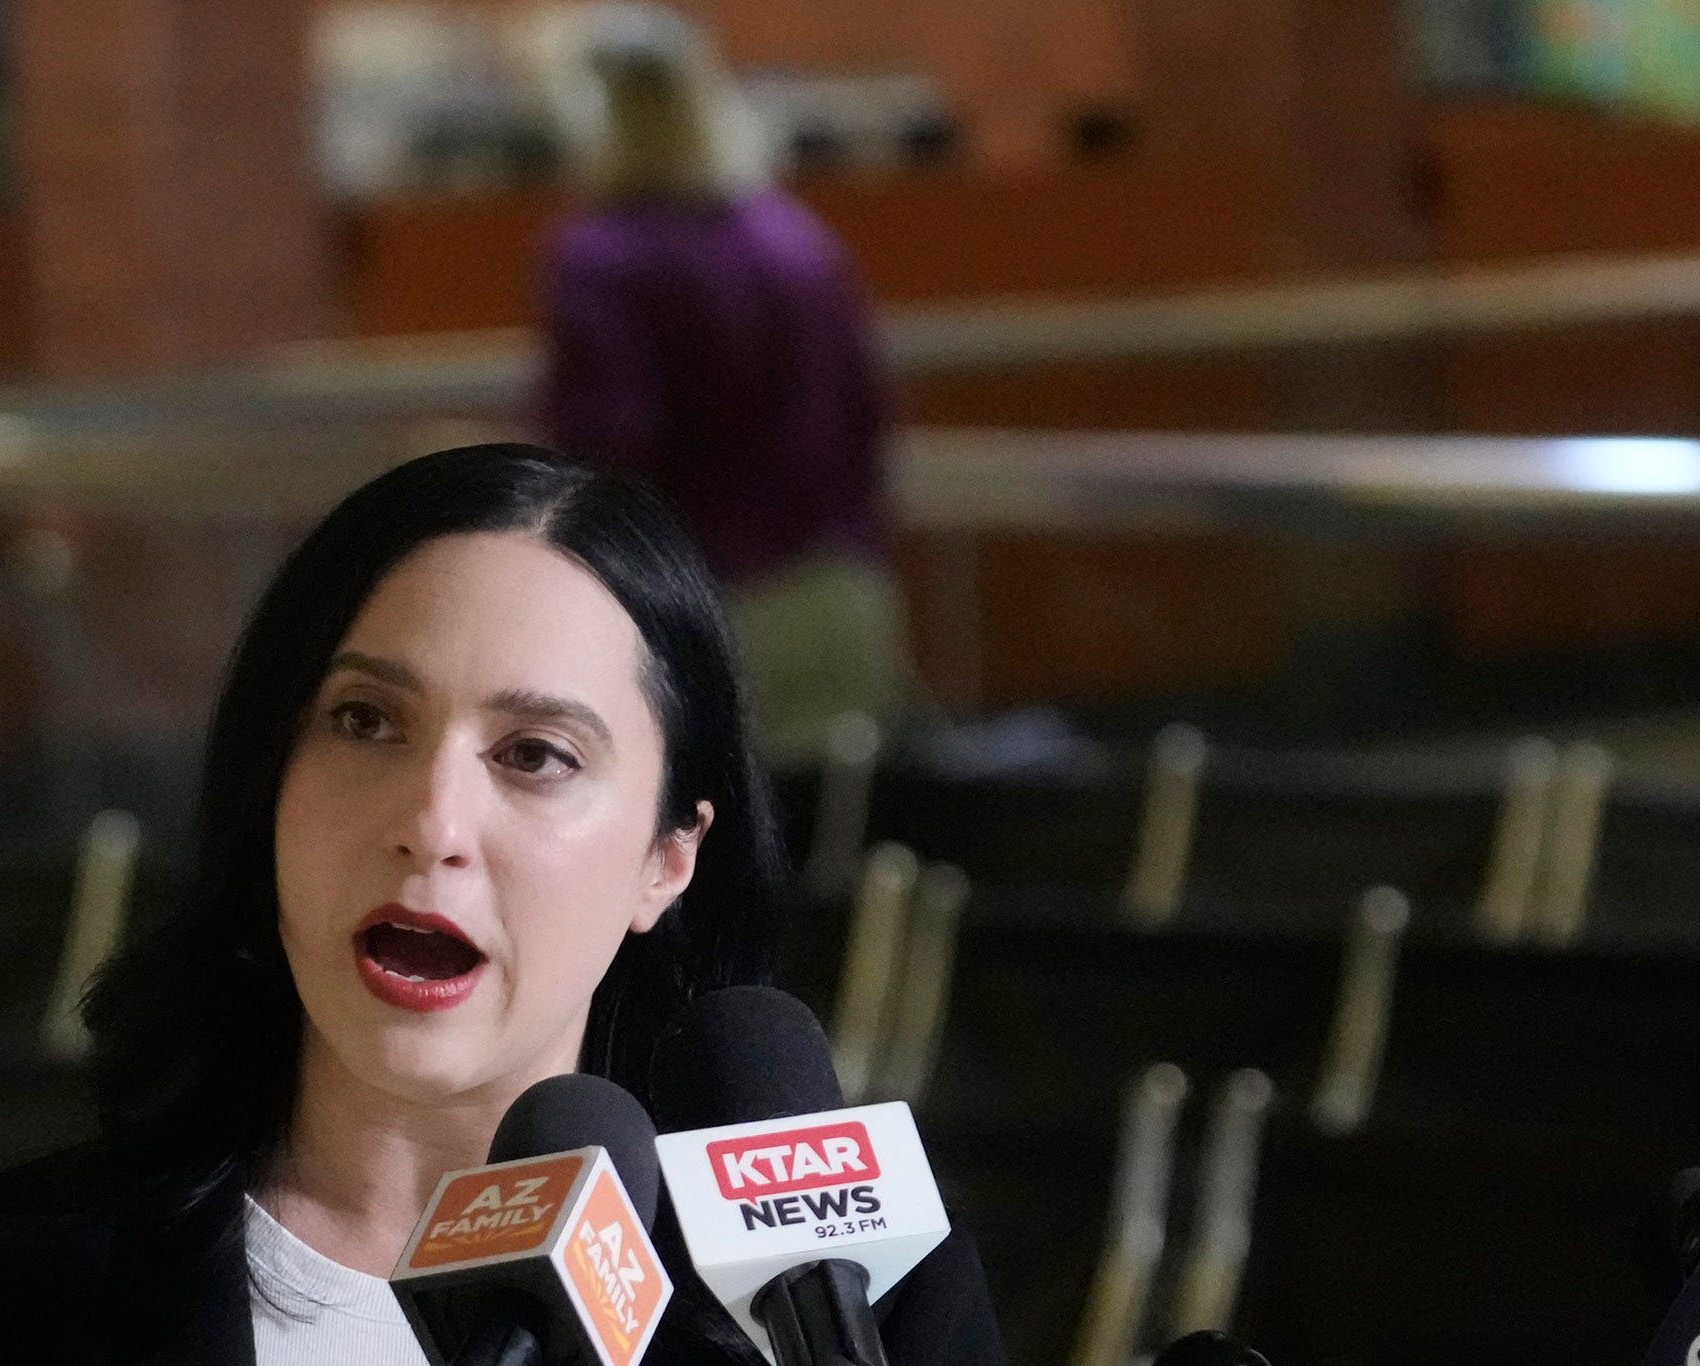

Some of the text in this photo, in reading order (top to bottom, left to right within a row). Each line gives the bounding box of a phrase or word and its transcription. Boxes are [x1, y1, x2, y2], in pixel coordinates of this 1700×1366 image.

[722, 1136, 869, 1189] KTAR
[461, 1176, 549, 1215] AZ
[739, 1186, 882, 1231] NEWS
[429, 1203, 555, 1239] FAMILY
[815, 1217, 887, 1238] 92.3 FM
[579, 1219, 639, 1334] FAMILY
